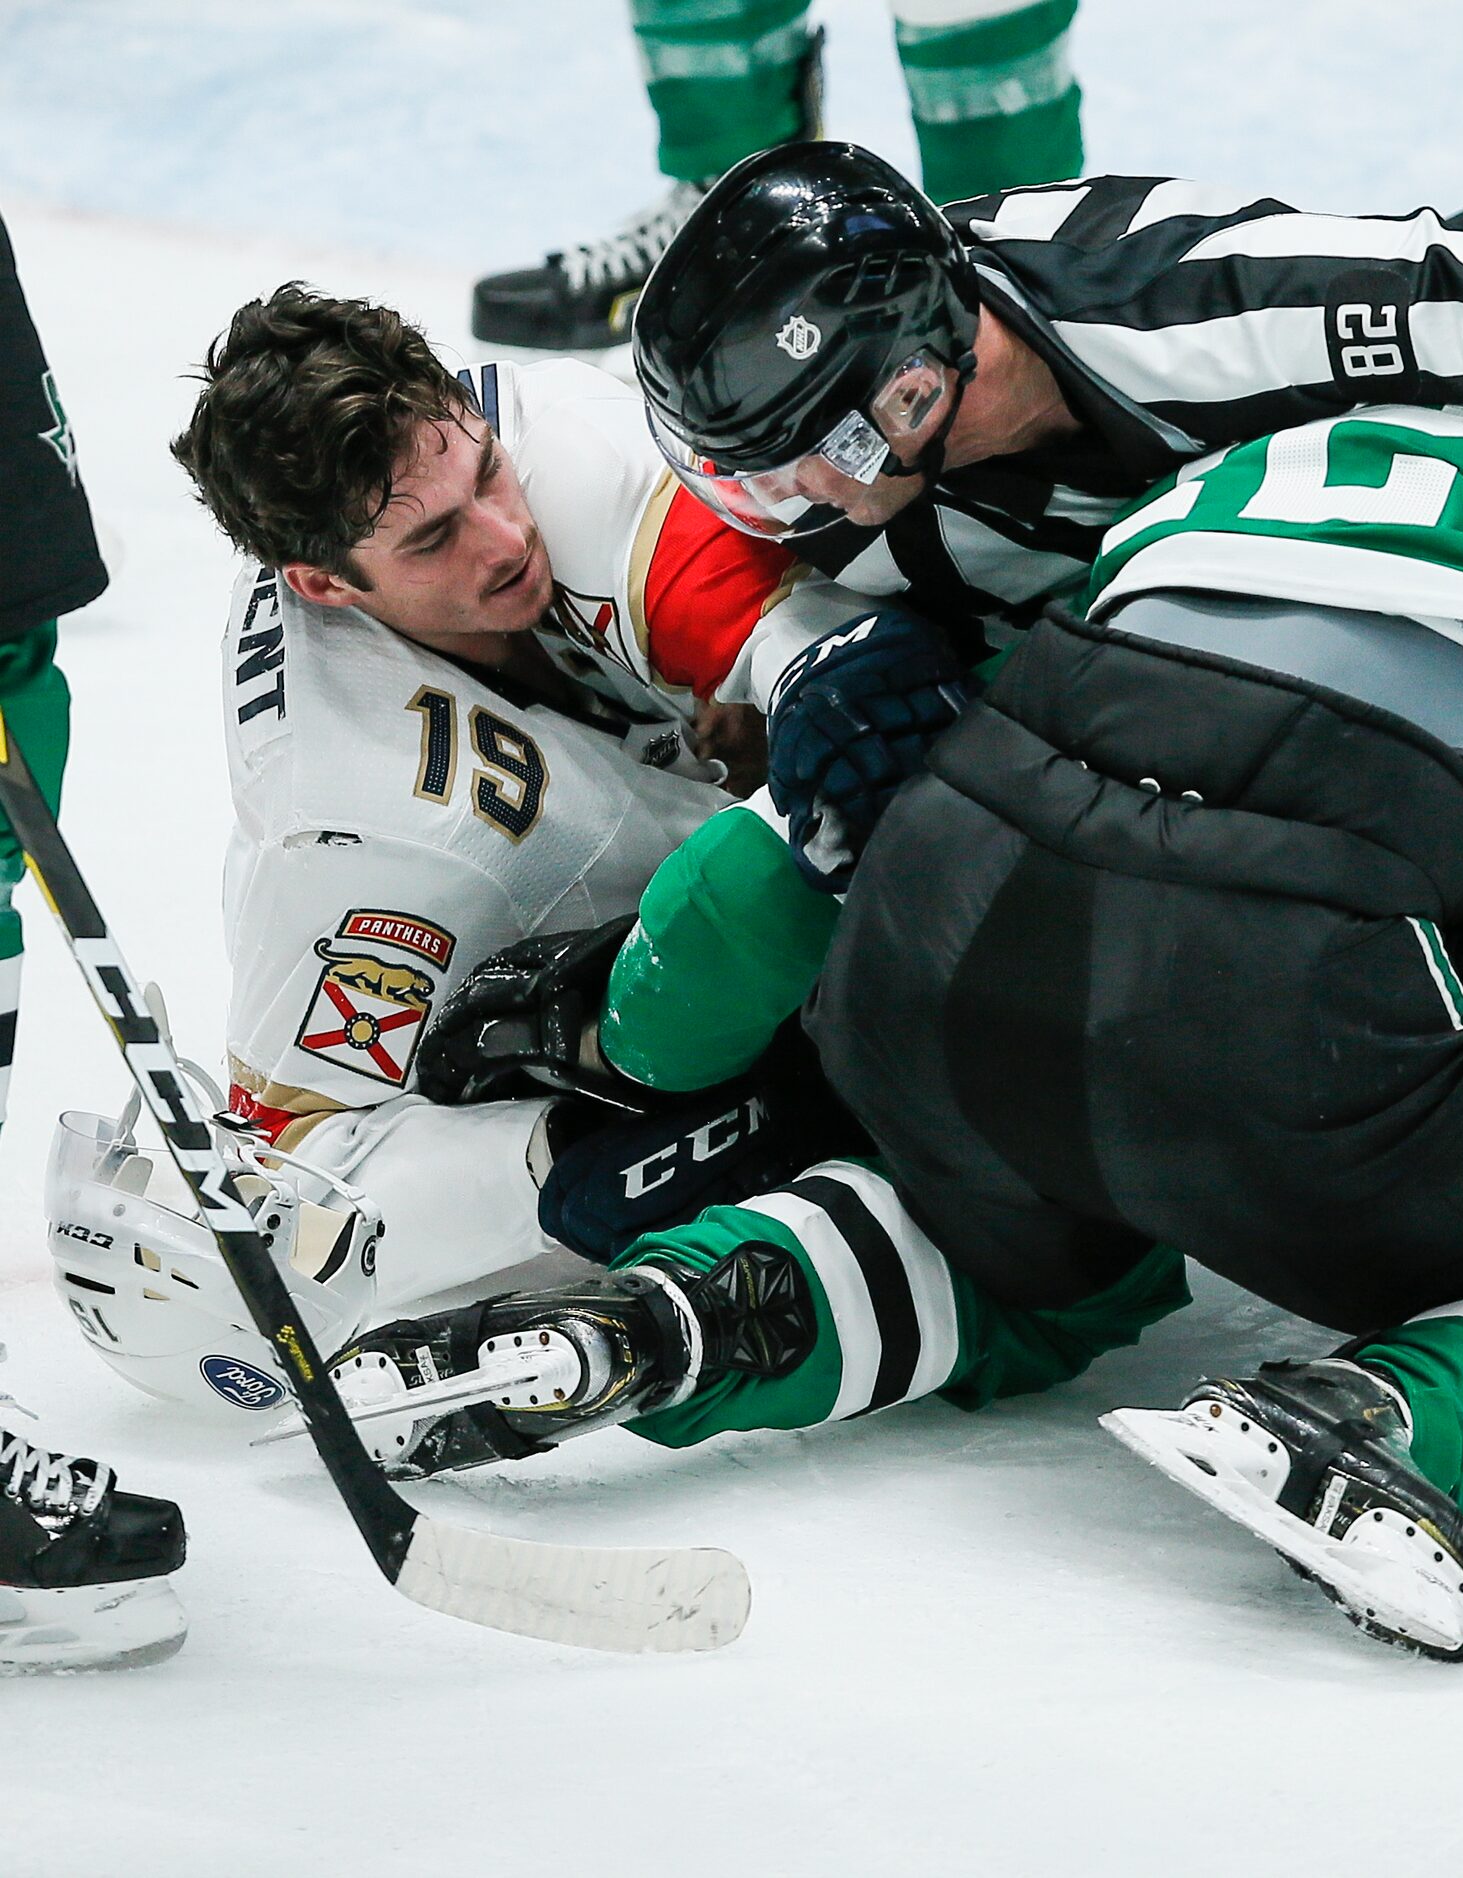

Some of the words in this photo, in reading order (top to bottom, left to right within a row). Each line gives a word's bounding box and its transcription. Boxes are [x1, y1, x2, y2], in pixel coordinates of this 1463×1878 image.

[1336, 303, 1404, 377] 82
[236, 568, 286, 725] ENT
[404, 684, 550, 847] 19
[358, 919, 441, 955] PANTHERS
[72, 937, 257, 1232] CCM
[56, 1221, 115, 1250] CCM
[215, 1366, 276, 1405] Ford
